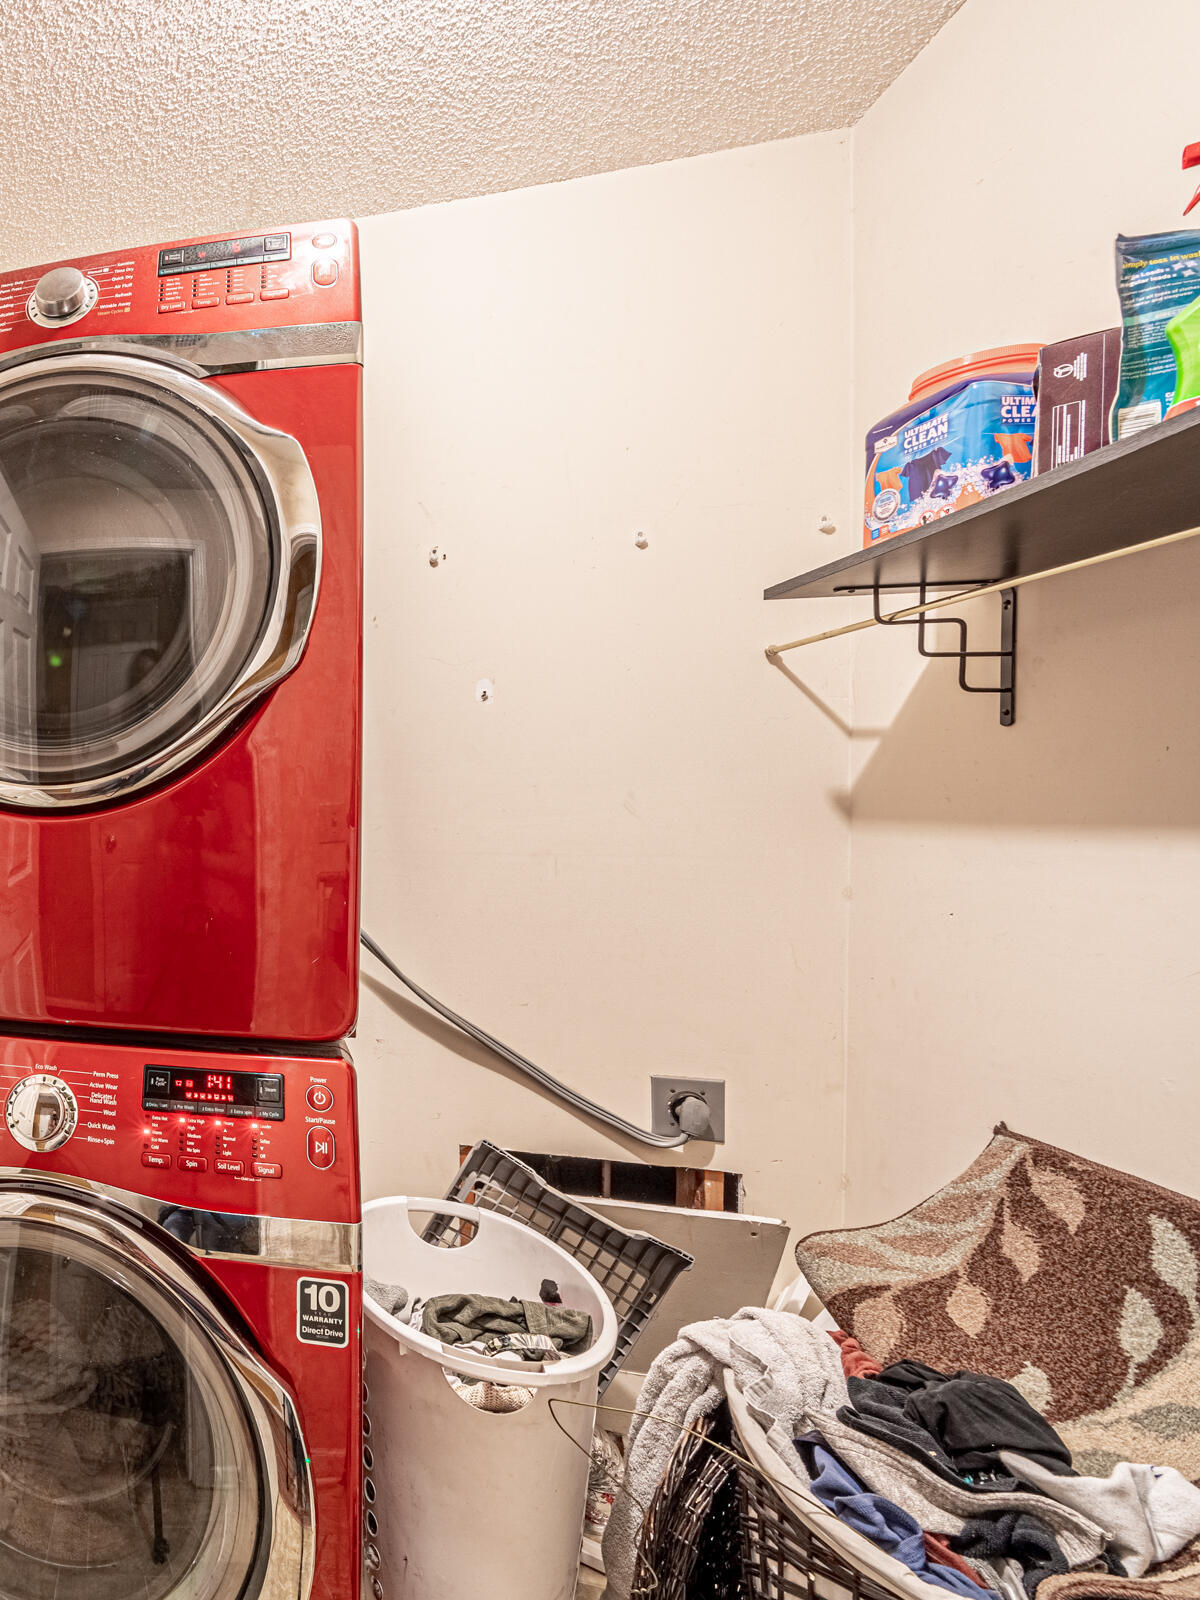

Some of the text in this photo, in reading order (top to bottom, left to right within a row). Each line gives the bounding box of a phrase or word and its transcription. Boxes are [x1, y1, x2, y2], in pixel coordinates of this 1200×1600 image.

[1001, 396, 1036, 406] ULTIM
[904, 413, 949, 439] ULTIMATE
[903, 421, 949, 450] CLEAN
[89, 1081, 104, 1089] Active
[305, 1115, 336, 1125] Start/Pause
[87, 1121, 116, 1131] Quick Wash
[148, 1155, 164, 1165] Temp.
[186, 1159, 198, 1168] Spin
[217, 1162, 240, 1171] Soil Level
[258, 1166, 275, 1175] Signal
[304, 1284, 341, 1313] 10
[302, 1314, 343, 1326] WARRANTY
[302, 1325, 324, 1336] Direct
[324, 1328, 344, 1338] Drive
